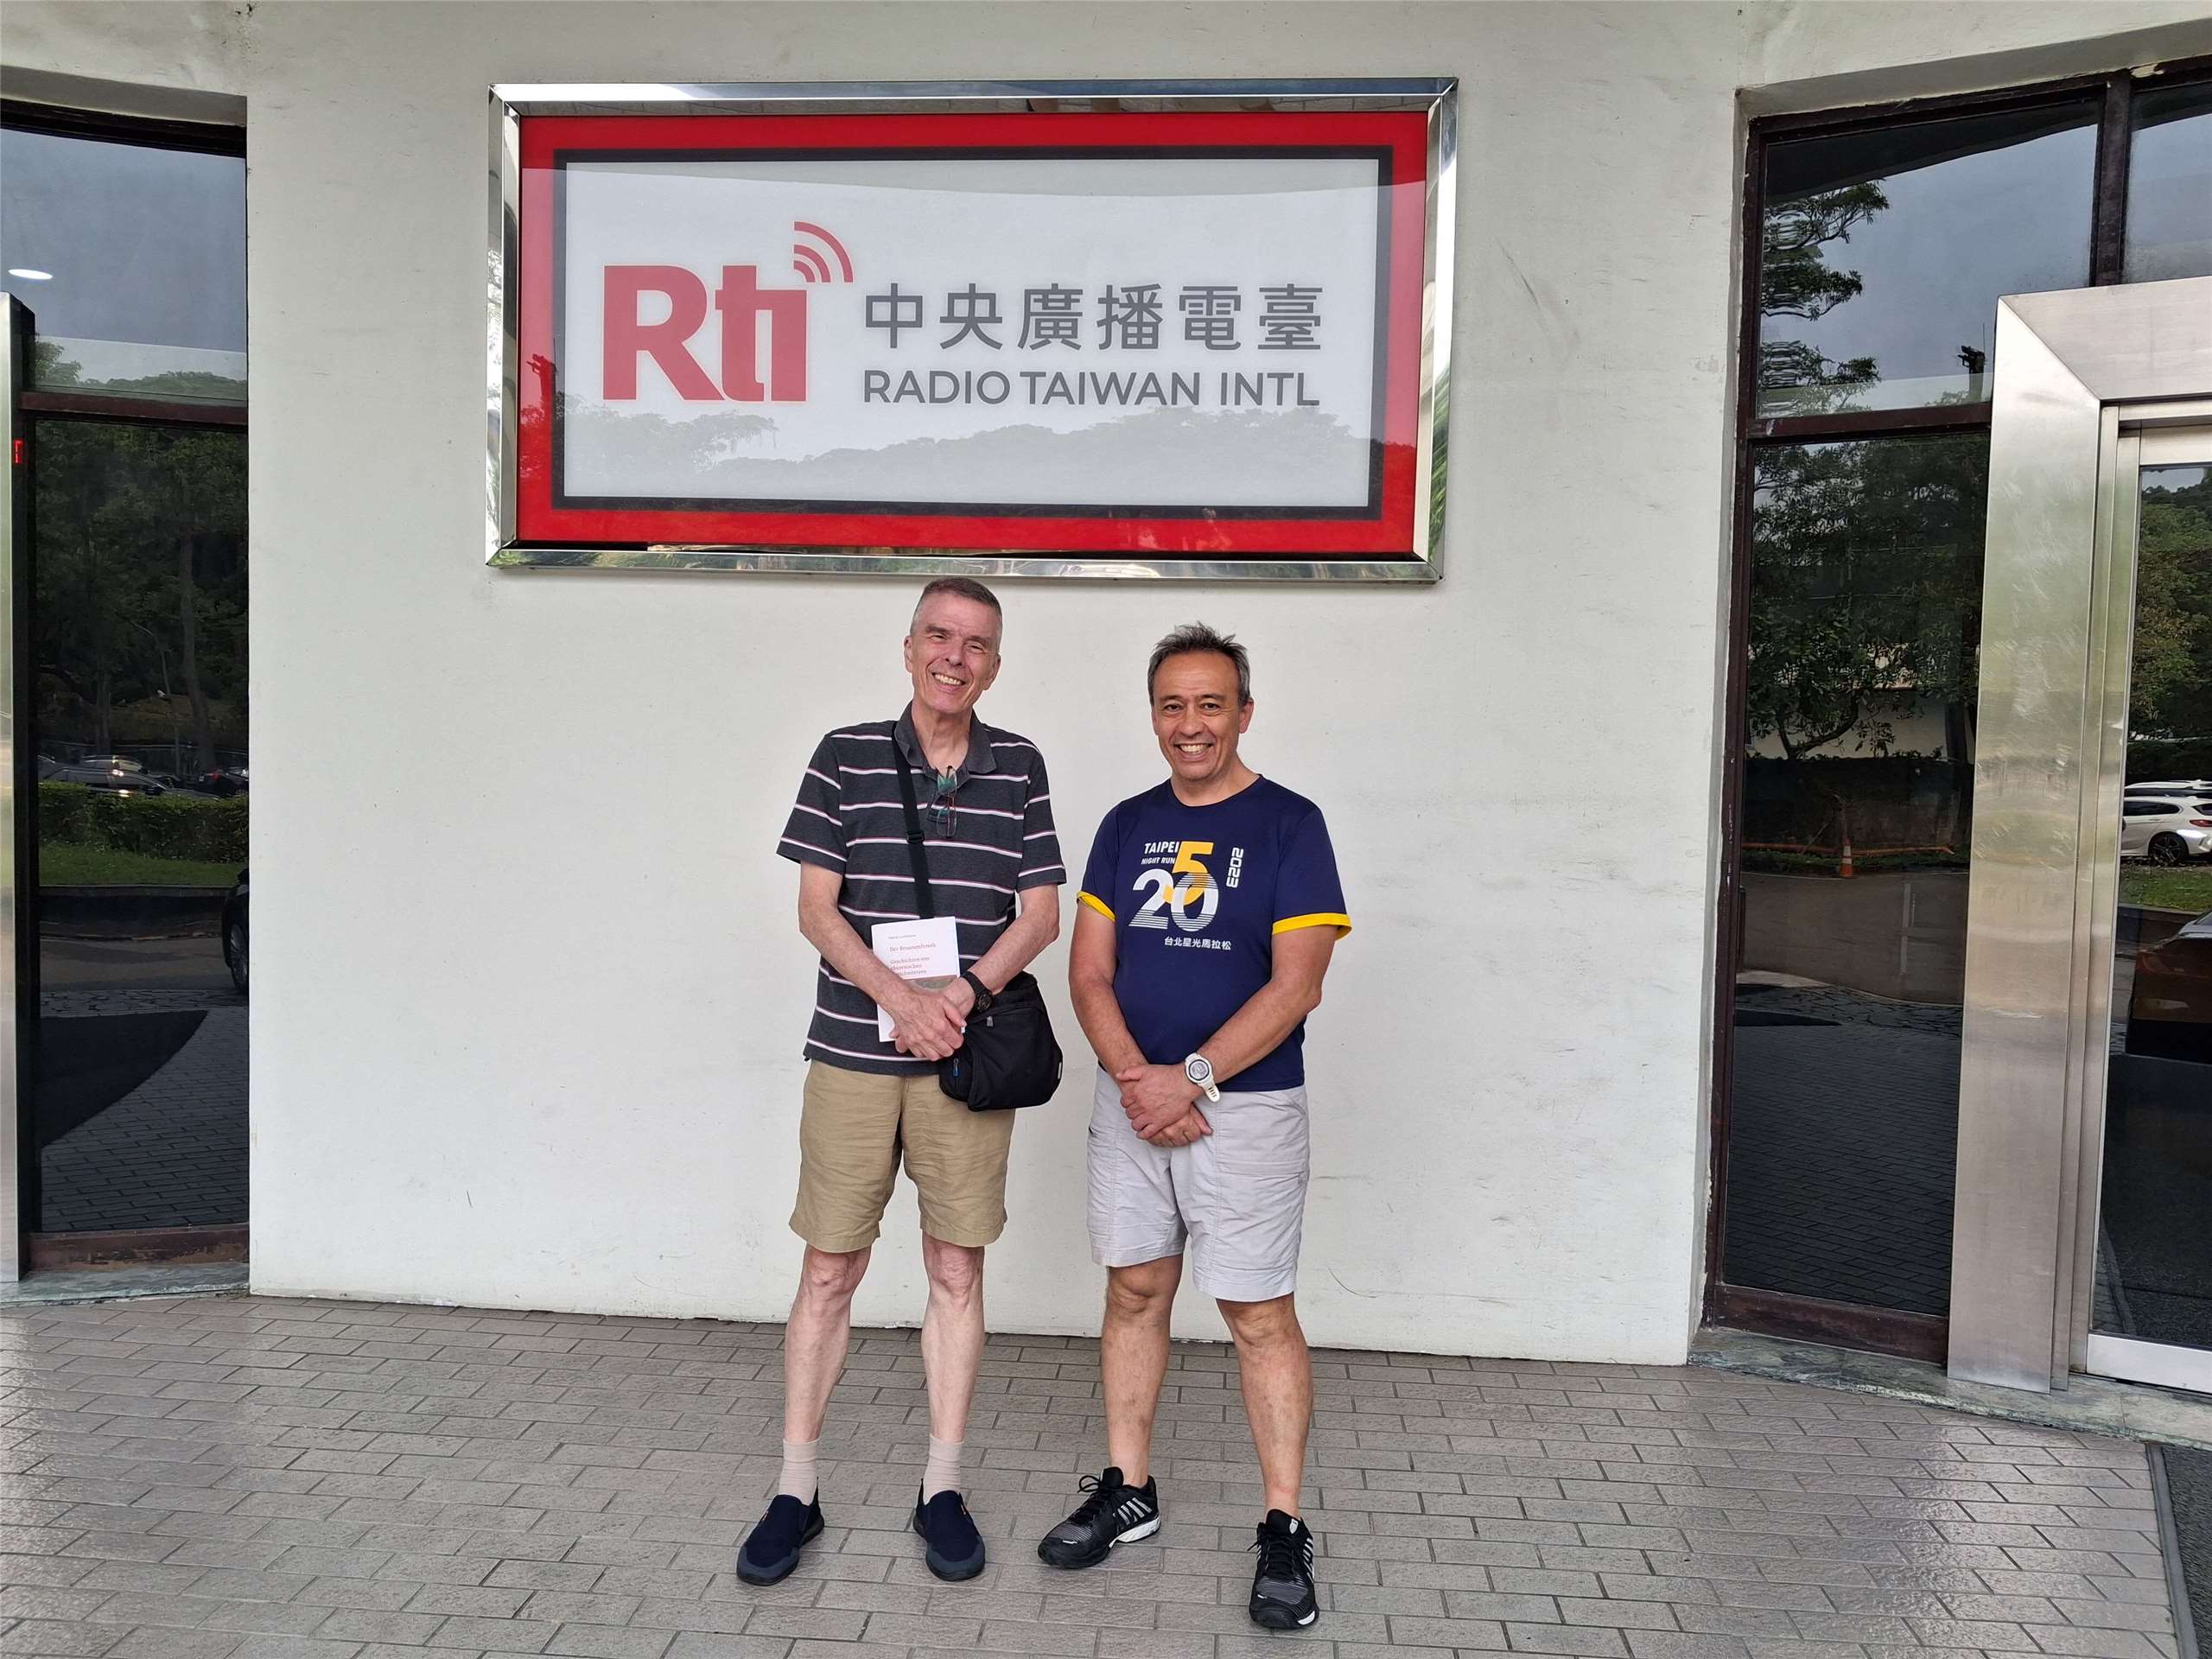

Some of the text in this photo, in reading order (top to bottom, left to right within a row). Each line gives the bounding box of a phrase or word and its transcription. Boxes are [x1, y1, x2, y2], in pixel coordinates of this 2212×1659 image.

[602, 264, 808, 402] Rti
[865, 283, 1323, 351] 中央廣播電臺
[863, 370, 1321, 407] RADIO TAIWAN INTL
[1143, 841, 1180, 855] TAIPEI
[1226, 847, 1244, 888] 2023
[1164, 936, 1231, 950] 台北星光馬拉松
